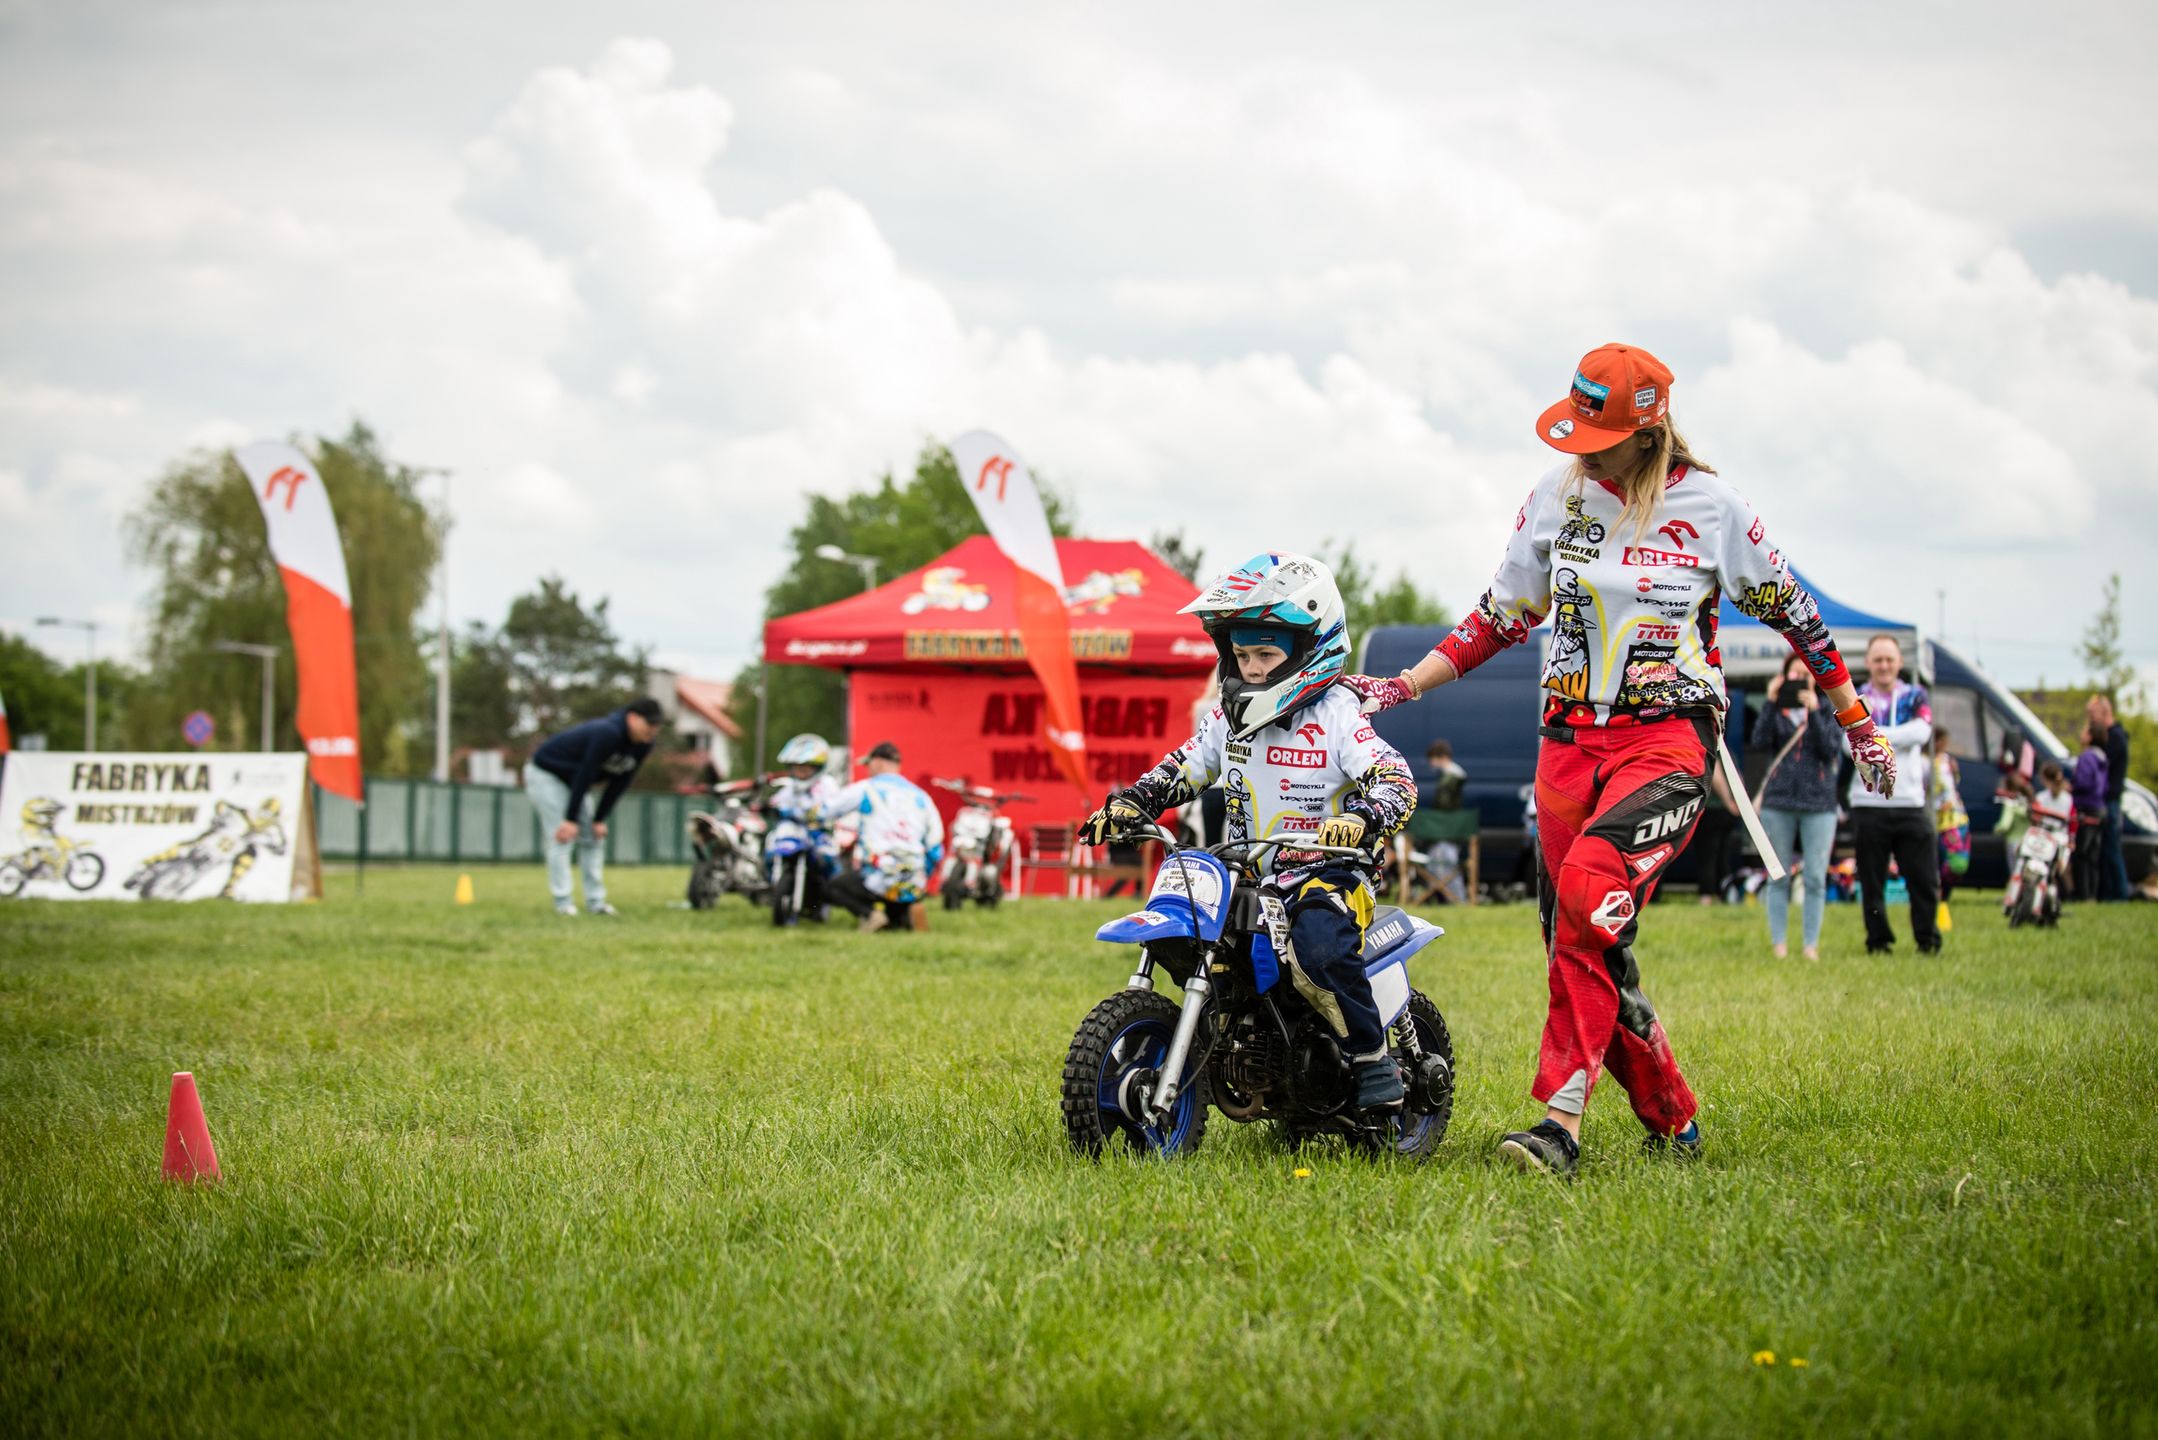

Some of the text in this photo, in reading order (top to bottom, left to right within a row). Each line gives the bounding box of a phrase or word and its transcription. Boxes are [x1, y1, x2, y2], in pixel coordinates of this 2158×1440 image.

[1628, 549, 1694, 567] ORLEN
[1637, 623, 1681, 640] TRW
[1226, 742, 1252, 757] FABRYKA
[1269, 749, 1323, 766] ORLEN
[71, 762, 212, 791] FABRYKA
[75, 802, 199, 824] MISTRZÓW
[1283, 817, 1322, 830] TRW
[1366, 920, 1406, 950] YAMAHA
